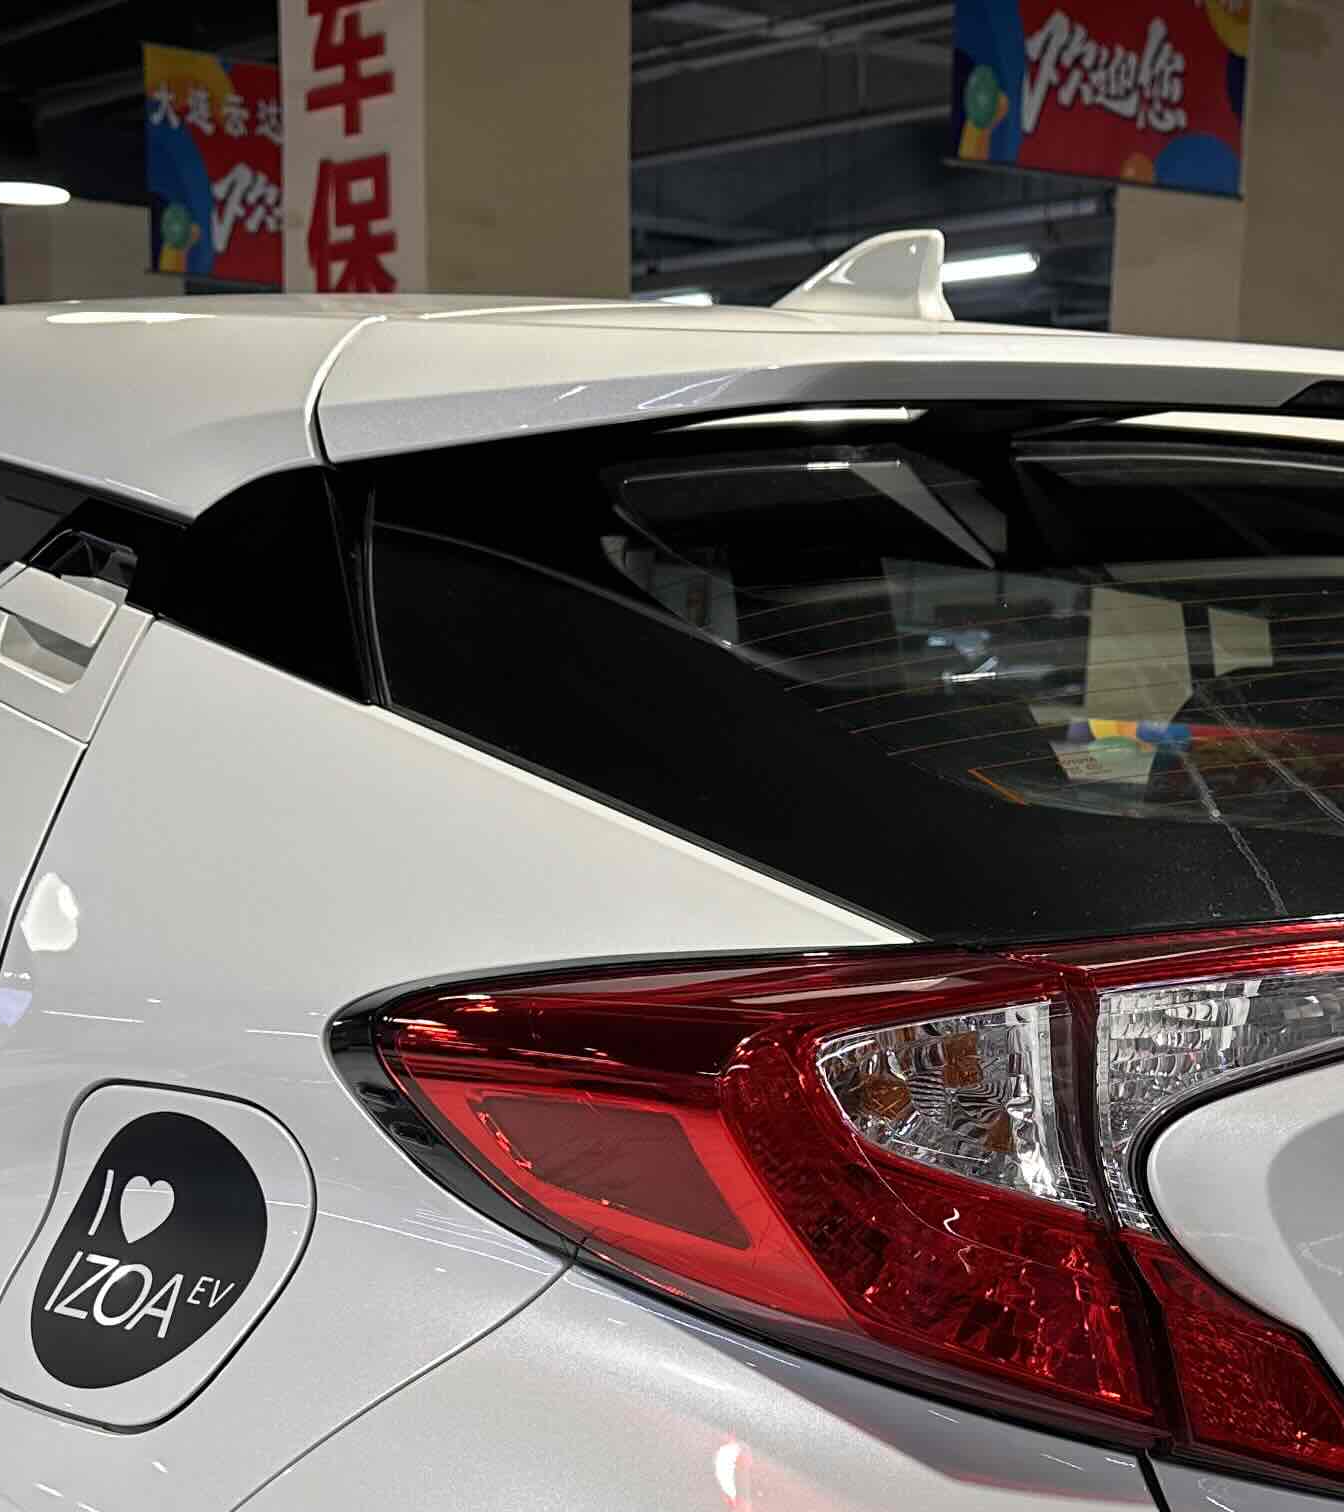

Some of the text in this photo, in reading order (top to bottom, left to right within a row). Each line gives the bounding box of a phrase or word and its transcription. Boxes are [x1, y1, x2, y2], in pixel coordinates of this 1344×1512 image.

[87, 1169, 114, 1236] I
[44, 1251, 235, 1338] IZOA EV
